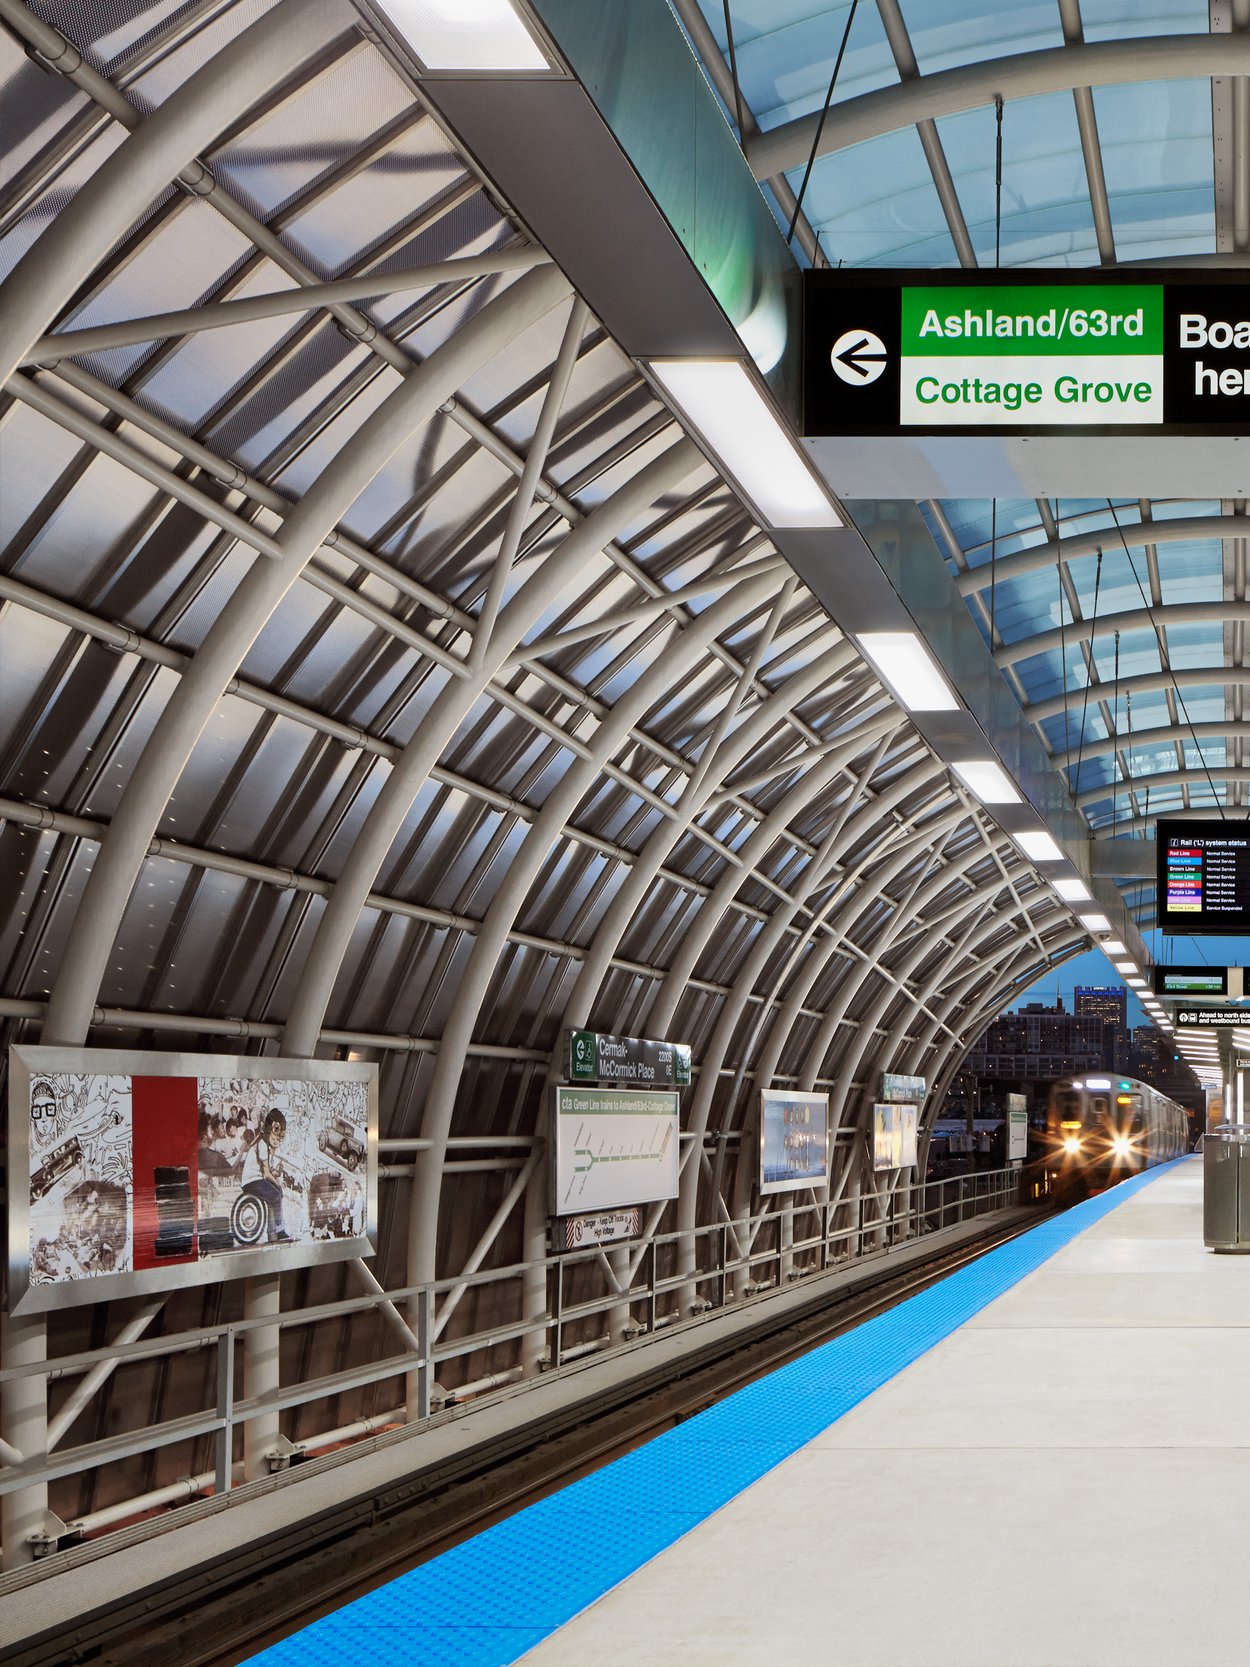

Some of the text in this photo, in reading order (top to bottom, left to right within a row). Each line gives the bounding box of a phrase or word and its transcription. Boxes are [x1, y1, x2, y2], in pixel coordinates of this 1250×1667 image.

[918, 308, 1144, 340] Ashland/63rd
[915, 375, 1152, 411] Cottage Grove
[600, 1039, 628, 1058] Cermak-
[658, 1051, 672, 1063] 2200S
[576, 1062, 593, 1072] Elevator
[600, 1060, 655, 1079] McCormick Place
[562, 1097, 572, 1110] cta
[573, 1099, 589, 1110] Green
[590, 1099, 599, 1110] Line
[600, 1100, 613, 1110] trains
[614, 1101, 619, 1110] to
[602, 1227, 615, 1236] Voltage
